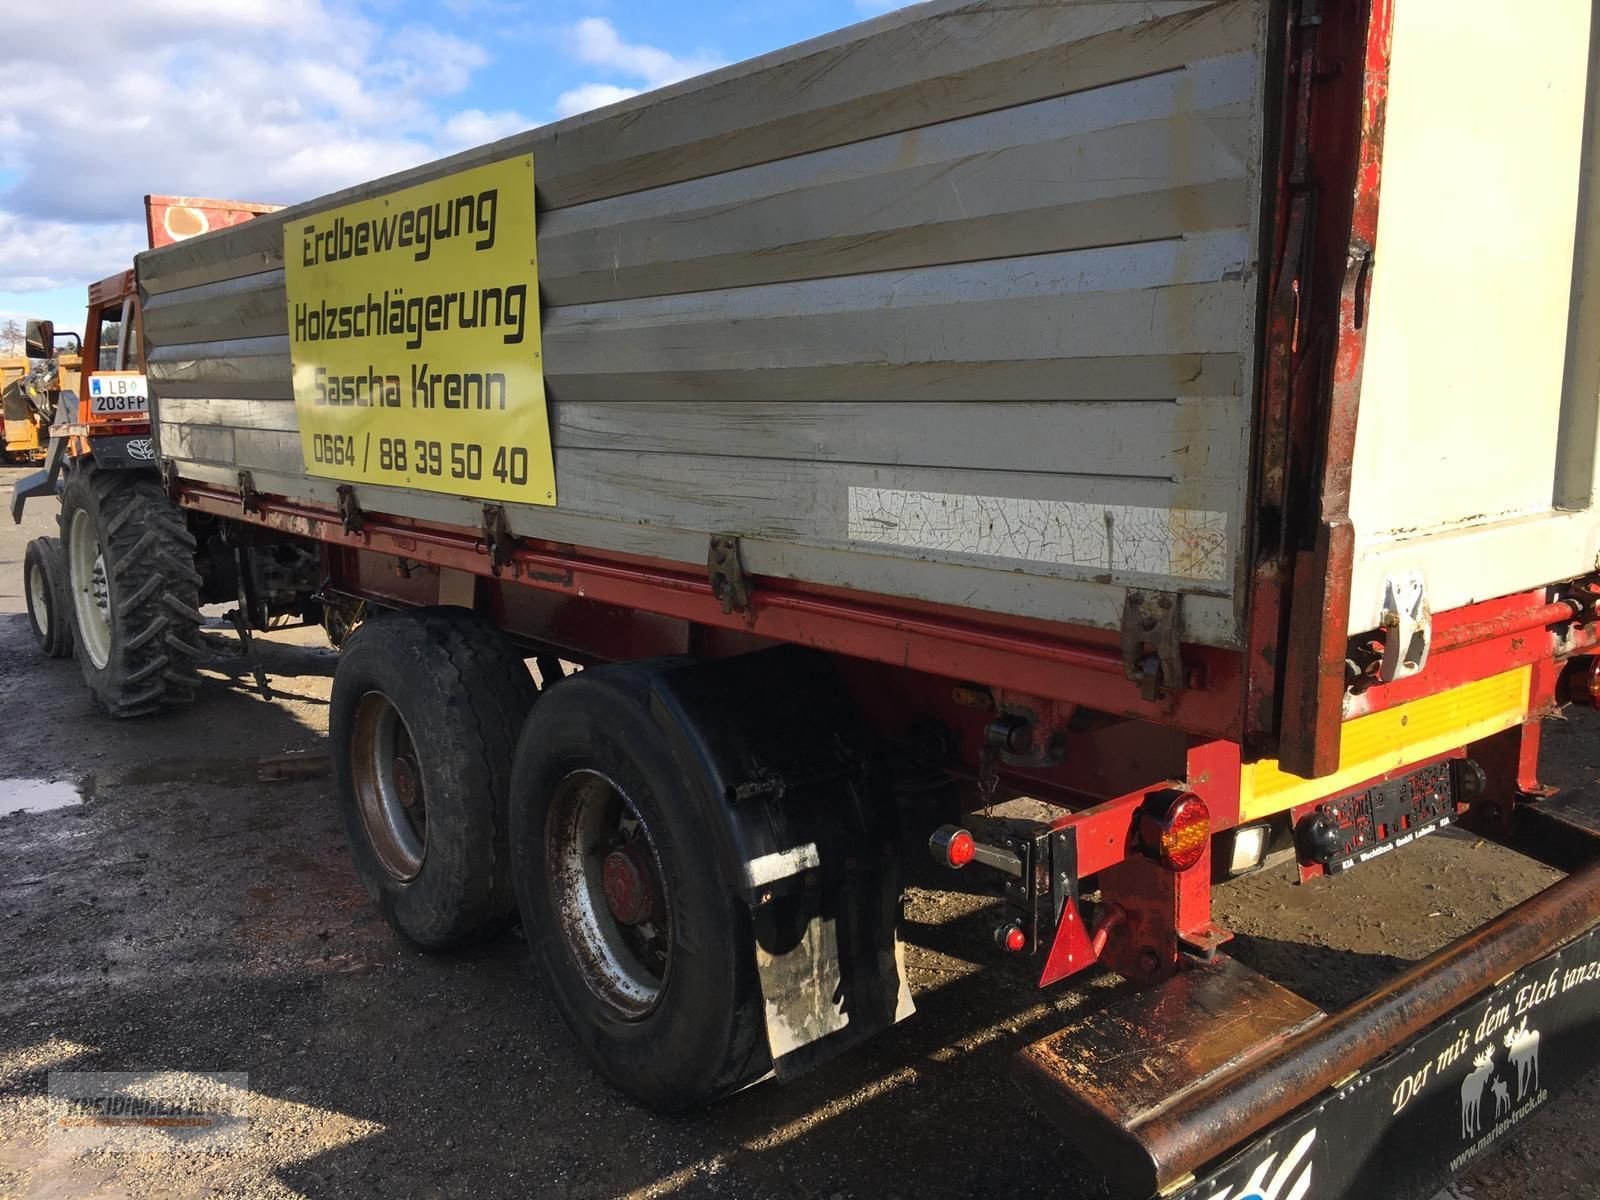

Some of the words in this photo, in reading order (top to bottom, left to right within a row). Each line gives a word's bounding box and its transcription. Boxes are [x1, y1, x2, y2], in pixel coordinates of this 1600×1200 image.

[303, 188, 498, 267] Erdbewegung
[295, 284, 527, 350] Holzschlägerung
[109, 380, 127, 395] LB
[314, 365, 401, 408] Sascha
[411, 363, 506, 410] Krenn
[313, 433, 356, 467] 0664
[363, 432, 371, 473] /
[380, 437, 408, 472] 88
[414, 439, 442, 476] 39
[451, 442, 482, 481] 50
[493, 446, 528, 486] 40
[1392, 1060, 1433, 1116] Der
[1436, 1030, 1471, 1075] mit
[1474, 1003, 1510, 1045] dem
[1515, 967, 1560, 1017] Elch
